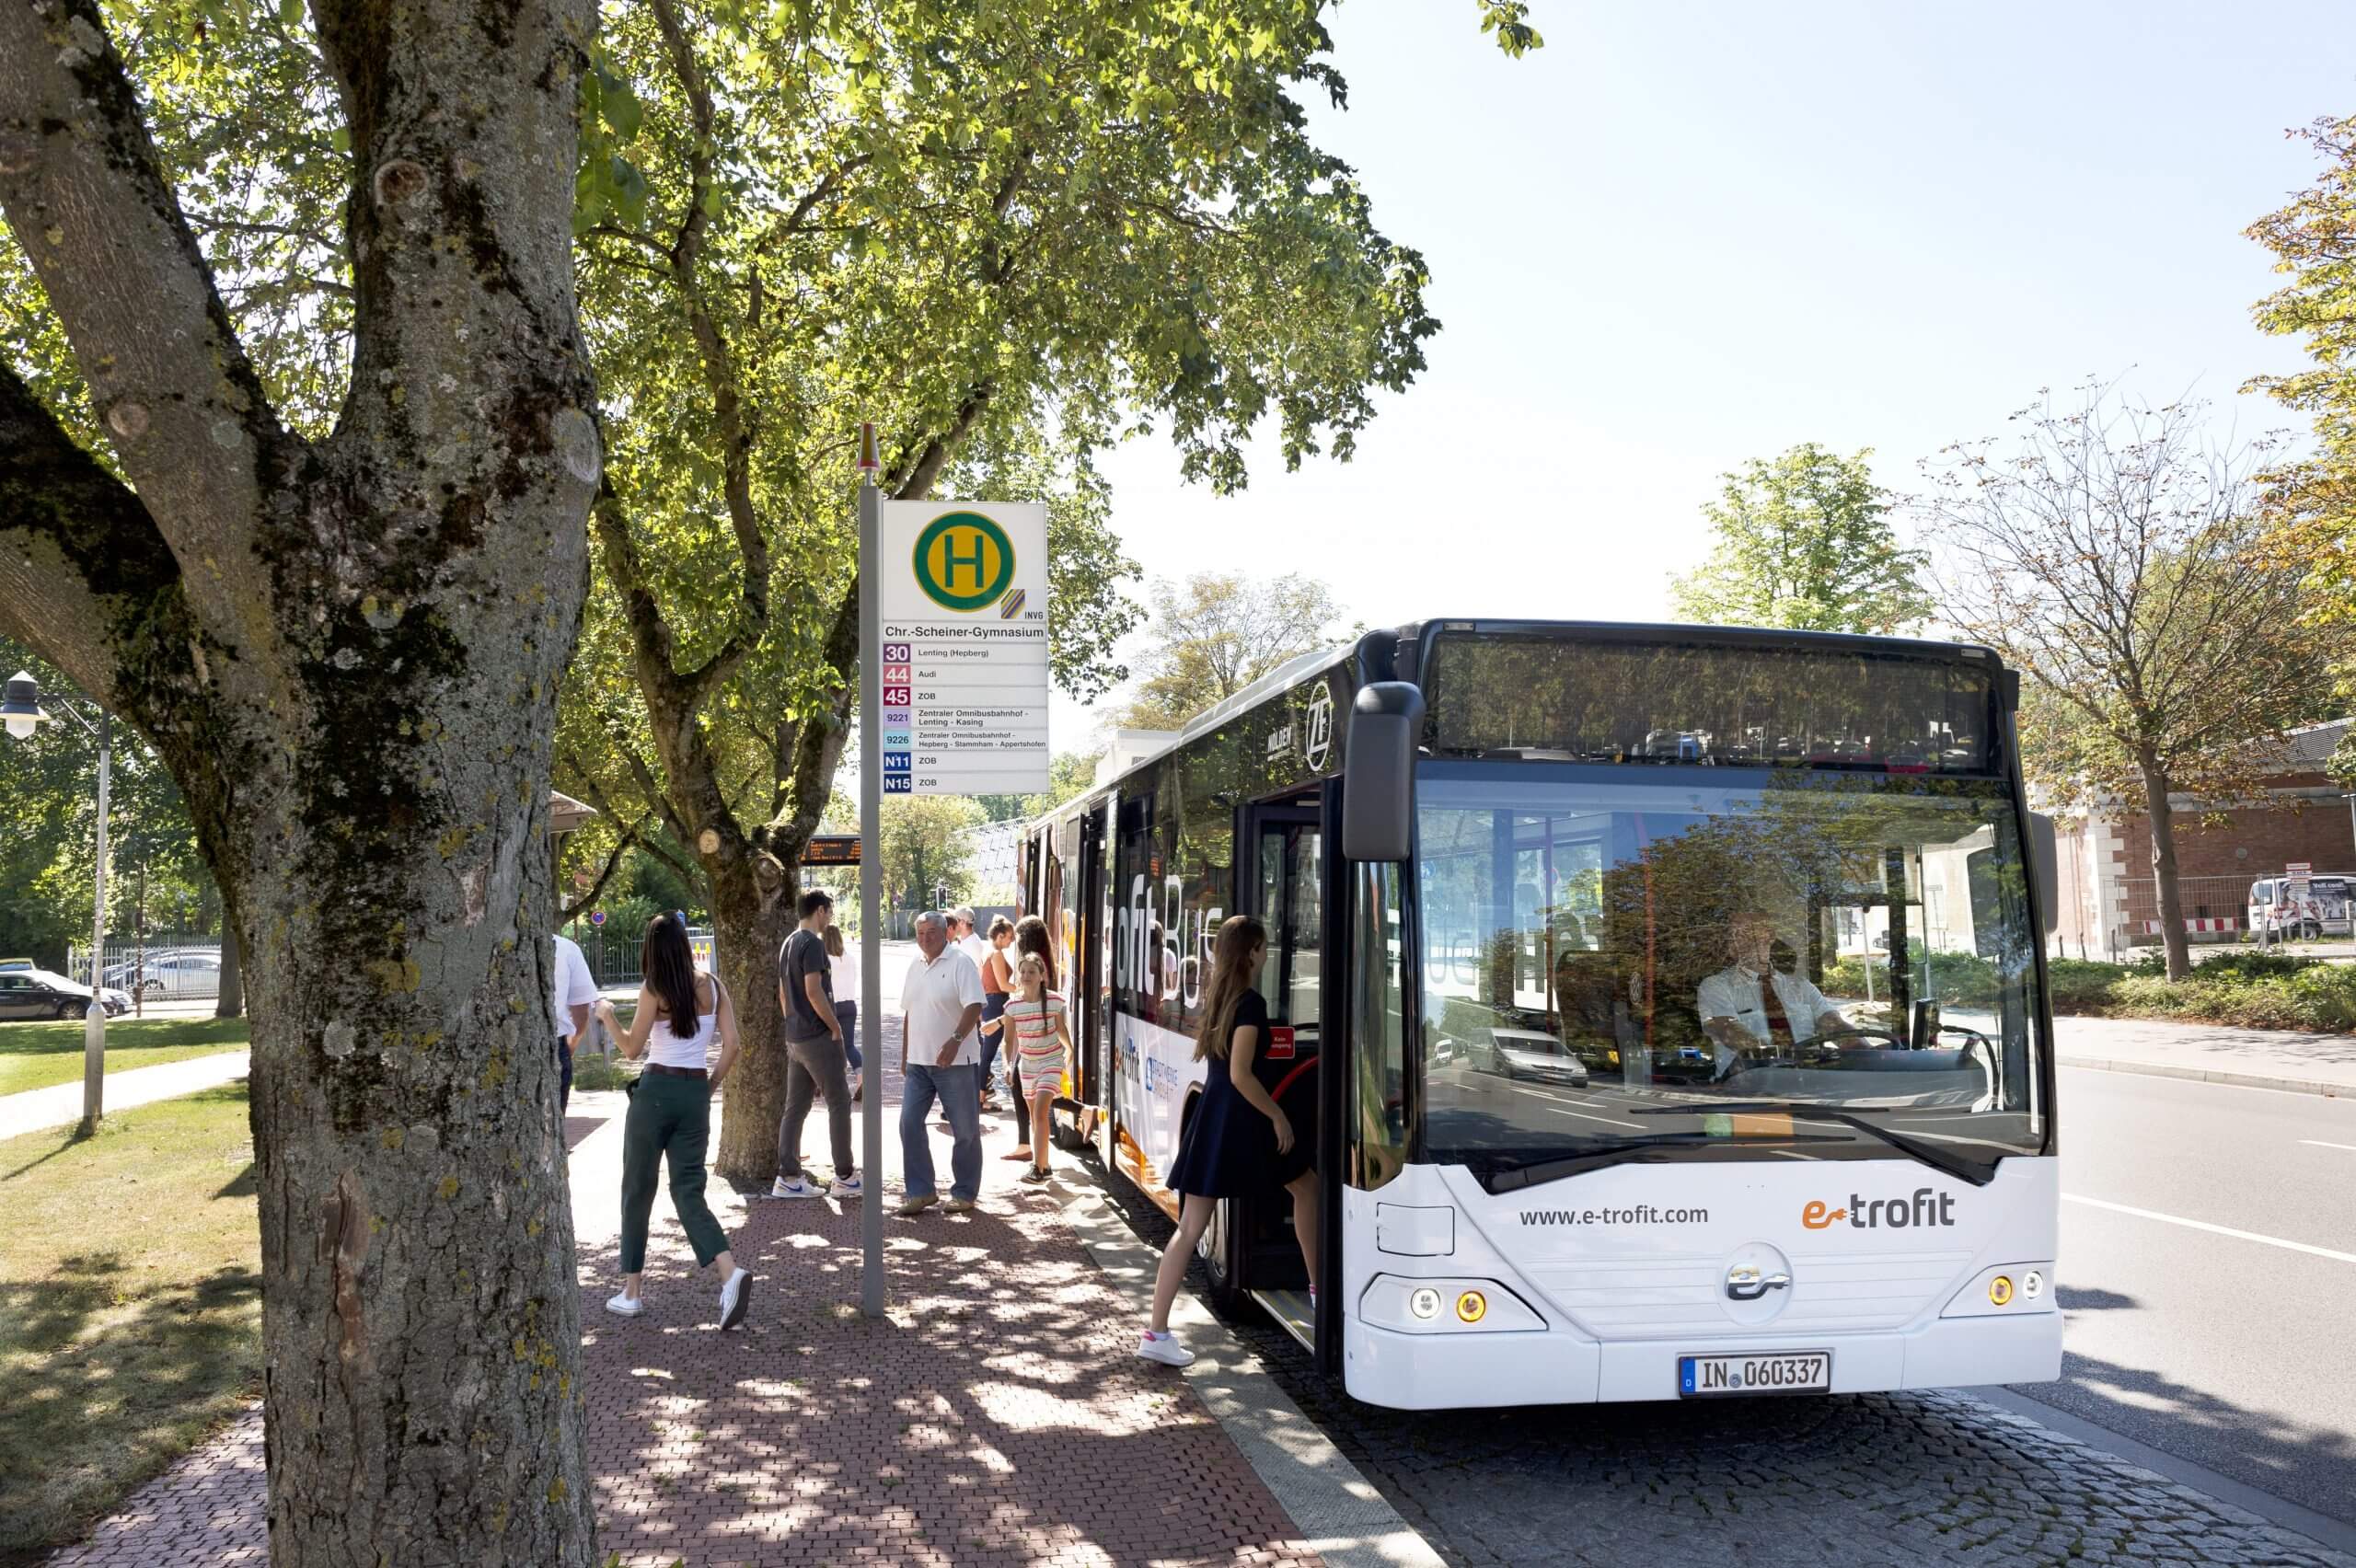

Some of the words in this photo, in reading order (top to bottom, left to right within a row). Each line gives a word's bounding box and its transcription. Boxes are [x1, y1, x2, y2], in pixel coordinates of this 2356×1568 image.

[944, 535, 984, 588] H
[1024, 611, 1044, 619] INVG
[885, 627, 1045, 640] Chr.-Scheiner-Gymnasium
[886, 646, 909, 661] 30
[918, 650, 948, 658] Lenting
[950, 650, 989, 658] (Hepberg)
[886, 667, 909, 683] 44
[886, 688, 909, 704] 45
[918, 692, 936, 700] ZOB
[887, 713, 908, 722] 9221
[956, 709, 1023, 718] Omnibusbahnhof
[918, 719, 948, 727] Lenting
[956, 719, 984, 728] Kasing
[886, 735, 909, 744] 9226
[885, 755, 909, 767] N11
[918, 756, 937, 765] ZOB
[885, 778, 911, 790] N15
[918, 778, 937, 787] ZOB
[1519, 1205, 1709, 1226] www.e-trofit.com
[1703, 1362, 1727, 1388] IN
[1744, 1358, 1822, 1387] 060337
